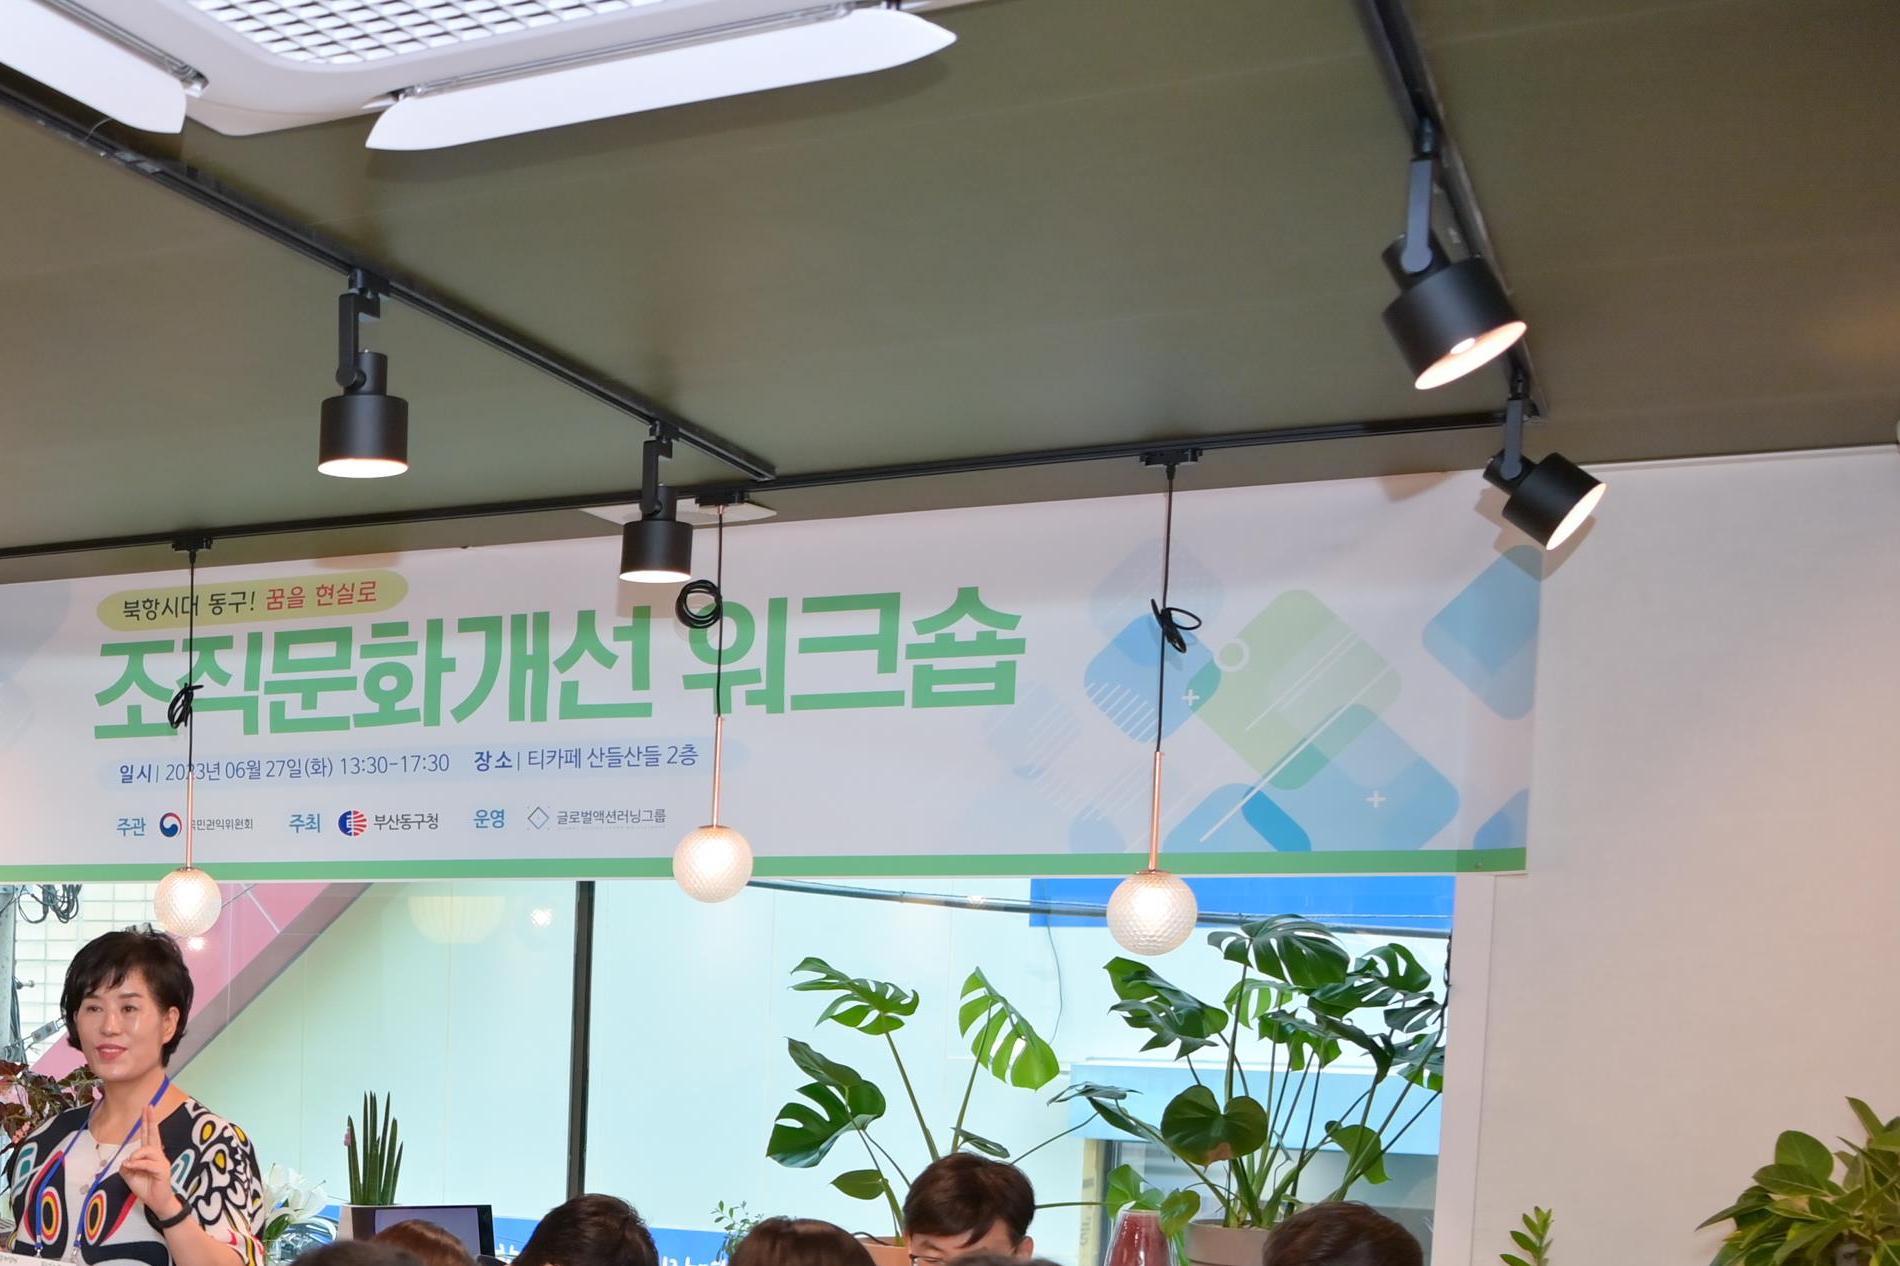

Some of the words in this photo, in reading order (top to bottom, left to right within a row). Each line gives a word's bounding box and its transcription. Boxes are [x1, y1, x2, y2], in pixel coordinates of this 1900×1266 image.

[122, 594, 199, 621] 북항시대
[208, 590, 255, 616] 동구!
[266, 586, 306, 611] 꿈을
[316, 580, 377, 607] 현실로
[93, 605, 653, 739] 조직문화개선
[682, 586, 1027, 715] 워크숍
[165, 762, 220, 782] 2023년
[225, 760, 261, 780] 06월
[265, 757, 333, 780] 27일(화)
[340, 753, 450, 775] 13:30-17:30
[528, 748, 581, 770] 티카페
[587, 745, 662, 769] 산들산들
[666, 743, 699, 766] 2층
[117, 816, 146, 837] 주관
[289, 813, 321, 833] 주최
[373, 812, 439, 831] 부산동구청
[473, 808, 505, 829] 운영
[557, 808, 667, 825] 글로벌액션러닝그룹
